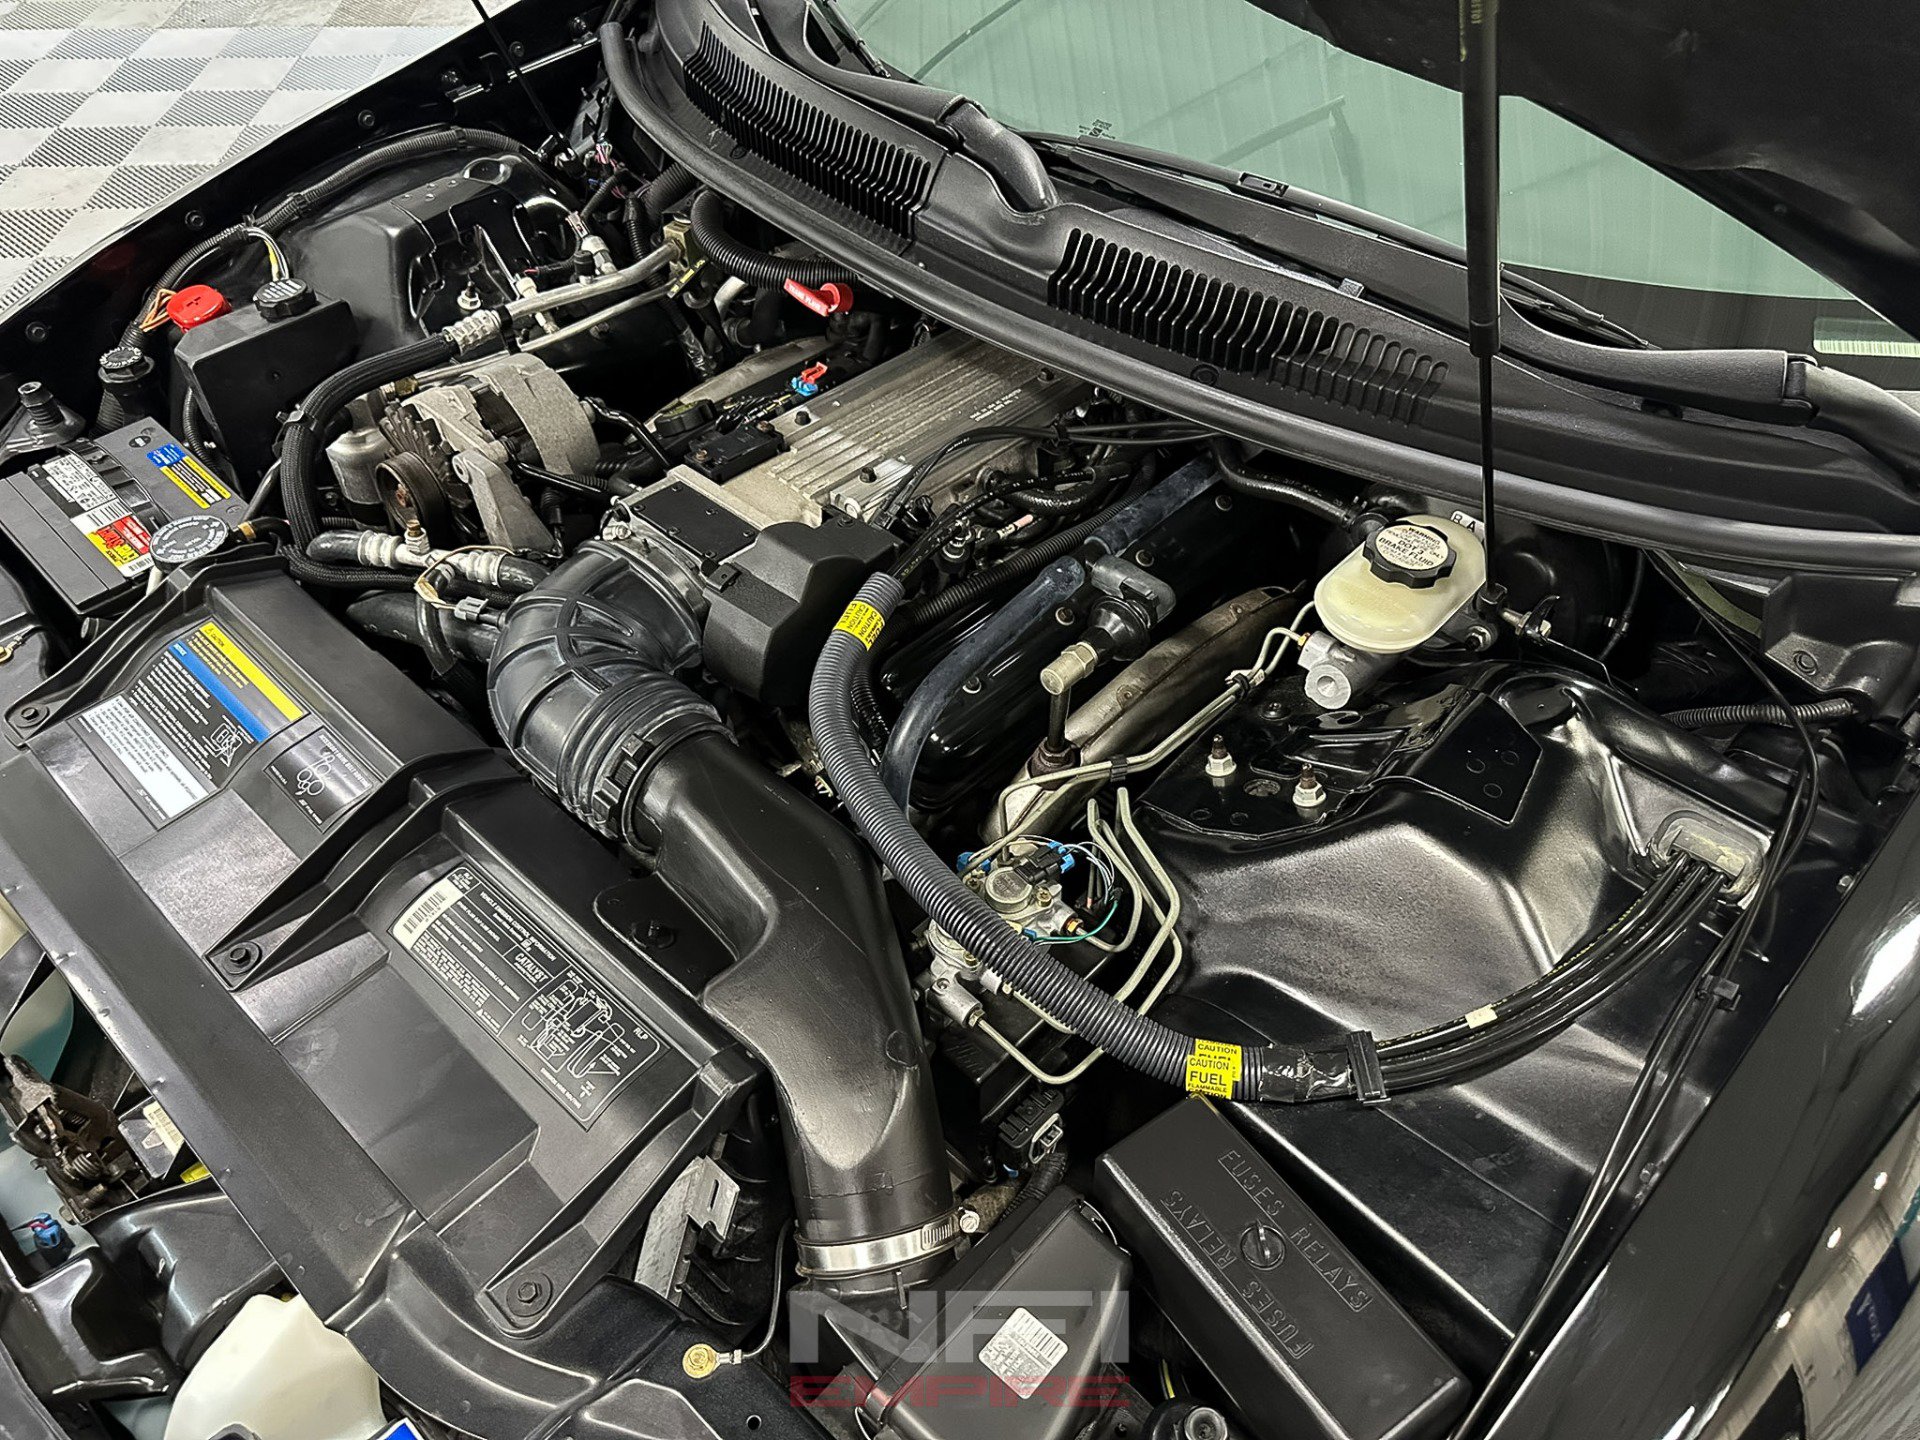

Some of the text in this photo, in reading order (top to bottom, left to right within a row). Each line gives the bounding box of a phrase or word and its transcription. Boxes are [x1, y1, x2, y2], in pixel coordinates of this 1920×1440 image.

[1407, 527, 1441, 544] WARNING
[1377, 536, 1434, 566] BRAKE FLUID
[1397, 539, 1417, 551] DOT
[1428, 550, 1444, 559] ONLY
[847, 604, 867, 630] CAUTION
[859, 610, 877, 637] CAUTION
[209, 632, 226, 648] CAUTION
[479, 890, 497, 907] VEHICLE
[493, 904, 514, 923] EMISSION
[510, 919, 531, 938] CONTROL
[527, 935, 556, 962] INFORMATION
[513, 951, 549, 984] CATALYST
[632, 1026, 649, 1042] RLP
[1198, 1044, 1238, 1055] CAUTION
[1190, 1058, 1230, 1071] CAUTION
[1190, 1071, 1227, 1086] FUEL
[1188, 1083, 1227, 1093] FLAMMABLE
[1218, 1150, 1371, 1310] FUSES RELAYS
[1163, 1190, 1314, 1358] FUSES RELAYS
